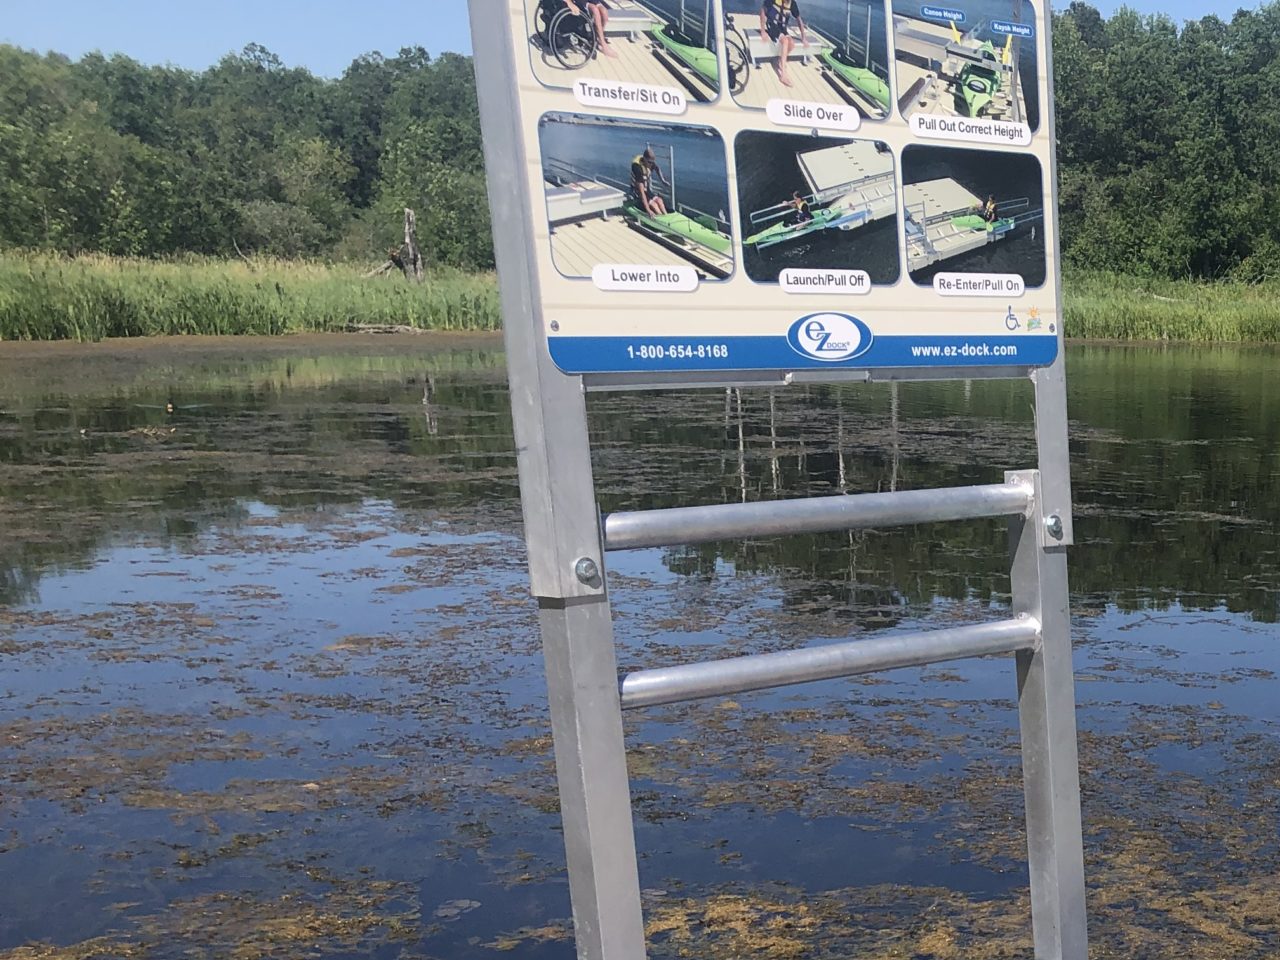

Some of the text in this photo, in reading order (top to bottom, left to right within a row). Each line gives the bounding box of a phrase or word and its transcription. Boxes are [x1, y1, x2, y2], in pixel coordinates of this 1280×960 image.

[943, 10, 963, 20] Height
[1012, 25, 1030, 34] Height
[579, 82, 680, 105] Transfer/Sit On
[784, 104, 843, 121] Slide Over
[918, 117, 1023, 139] Pull Out Correct Height
[611, 269, 680, 282] Lower Into
[786, 273, 864, 286] Launch/Pull Off
[939, 278, 1020, 290] Re-Enter/Pull On
[627, 345, 728, 358] 1-800-654-8168
[911, 343, 1017, 356] www.ez-dock.com
